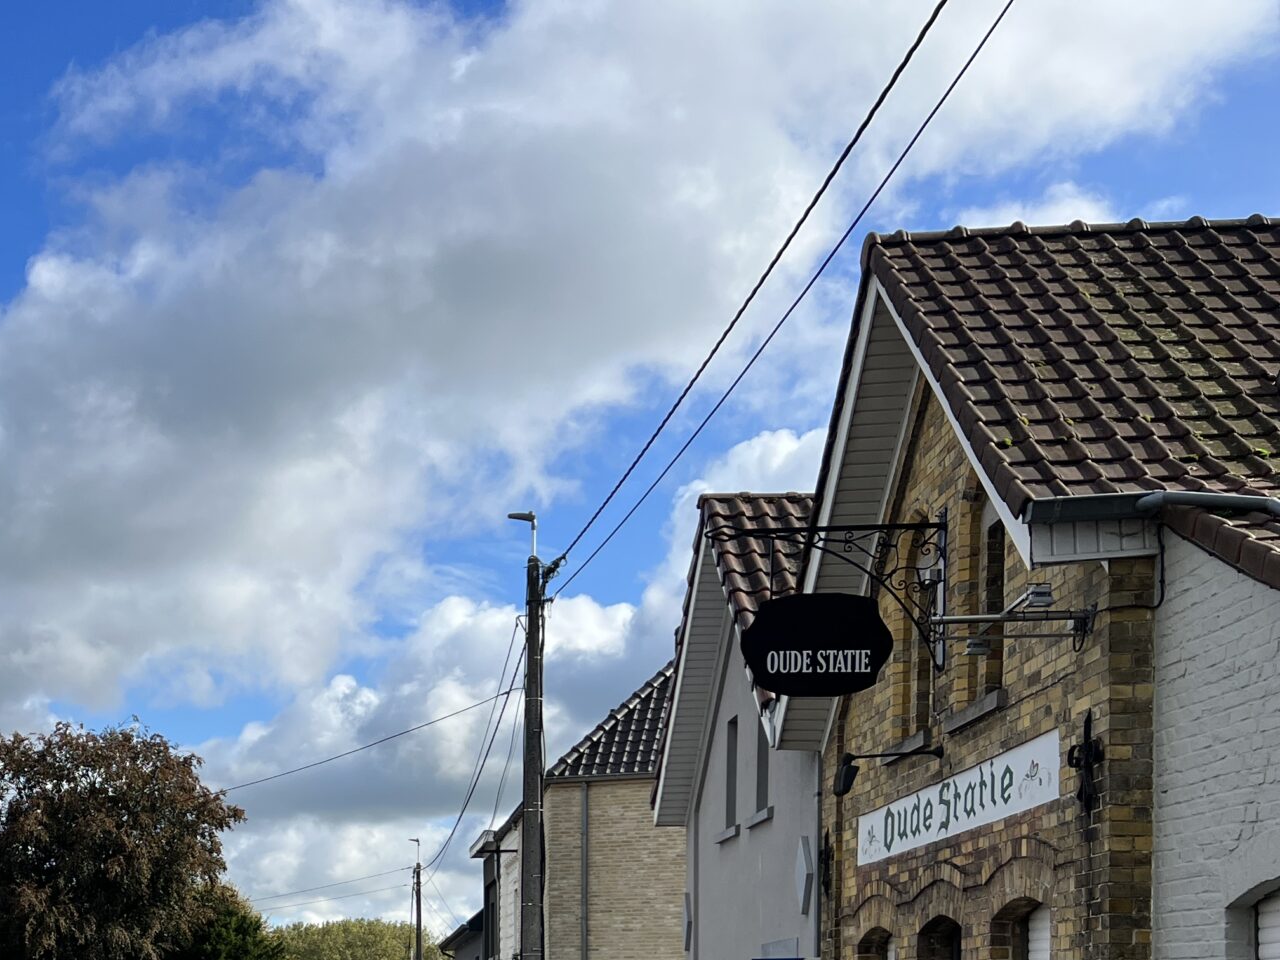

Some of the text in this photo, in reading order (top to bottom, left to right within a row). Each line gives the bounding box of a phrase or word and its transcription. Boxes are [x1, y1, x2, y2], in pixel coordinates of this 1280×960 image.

[766, 649, 871, 674] OUDE STATIE
[882, 759, 1015, 853] Oude Statie
